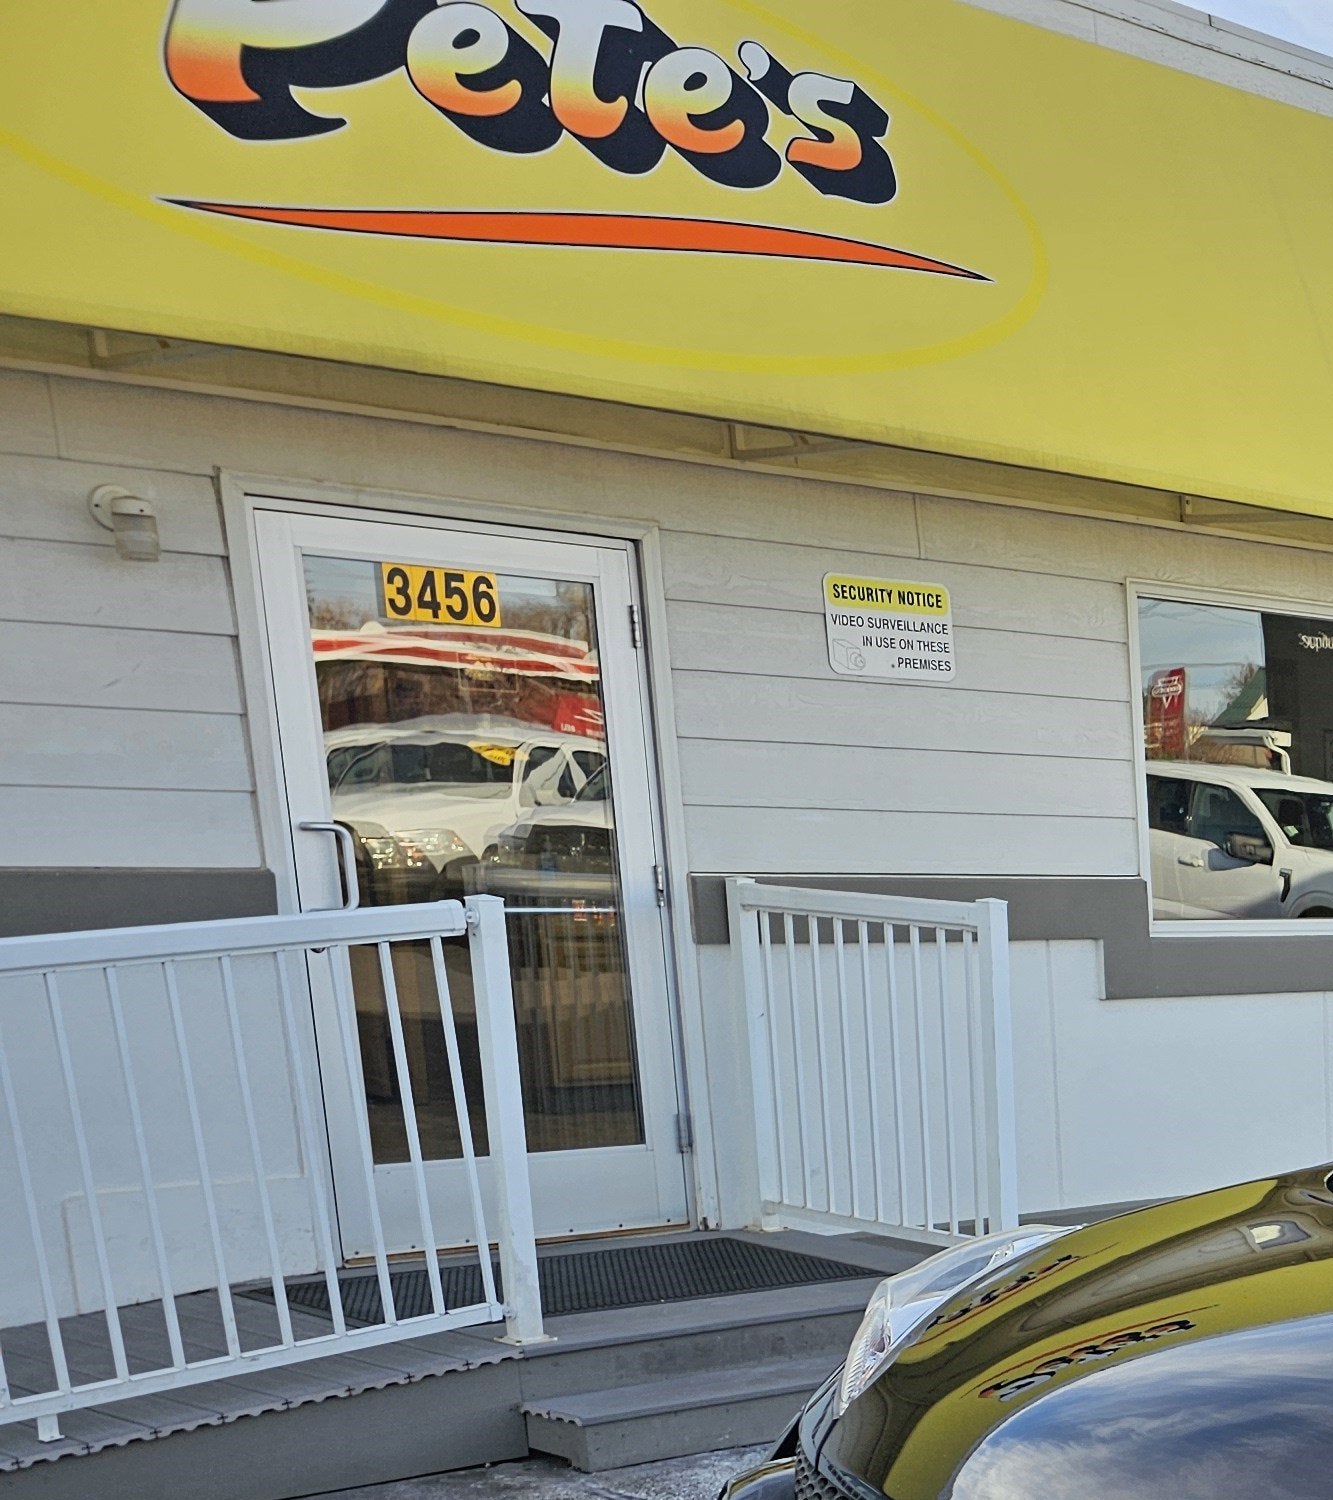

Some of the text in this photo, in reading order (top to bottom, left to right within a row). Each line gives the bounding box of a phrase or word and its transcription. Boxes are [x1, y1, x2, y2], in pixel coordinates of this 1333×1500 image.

[386, 567, 497, 623] 3456
[832, 583, 943, 609] SECURITY NOTICE
[830, 613, 949, 636] VIDEO SURVEILLANCE
[862, 635, 951, 654] IN USE ON THESE
[897, 656, 952, 672] PREMISES
